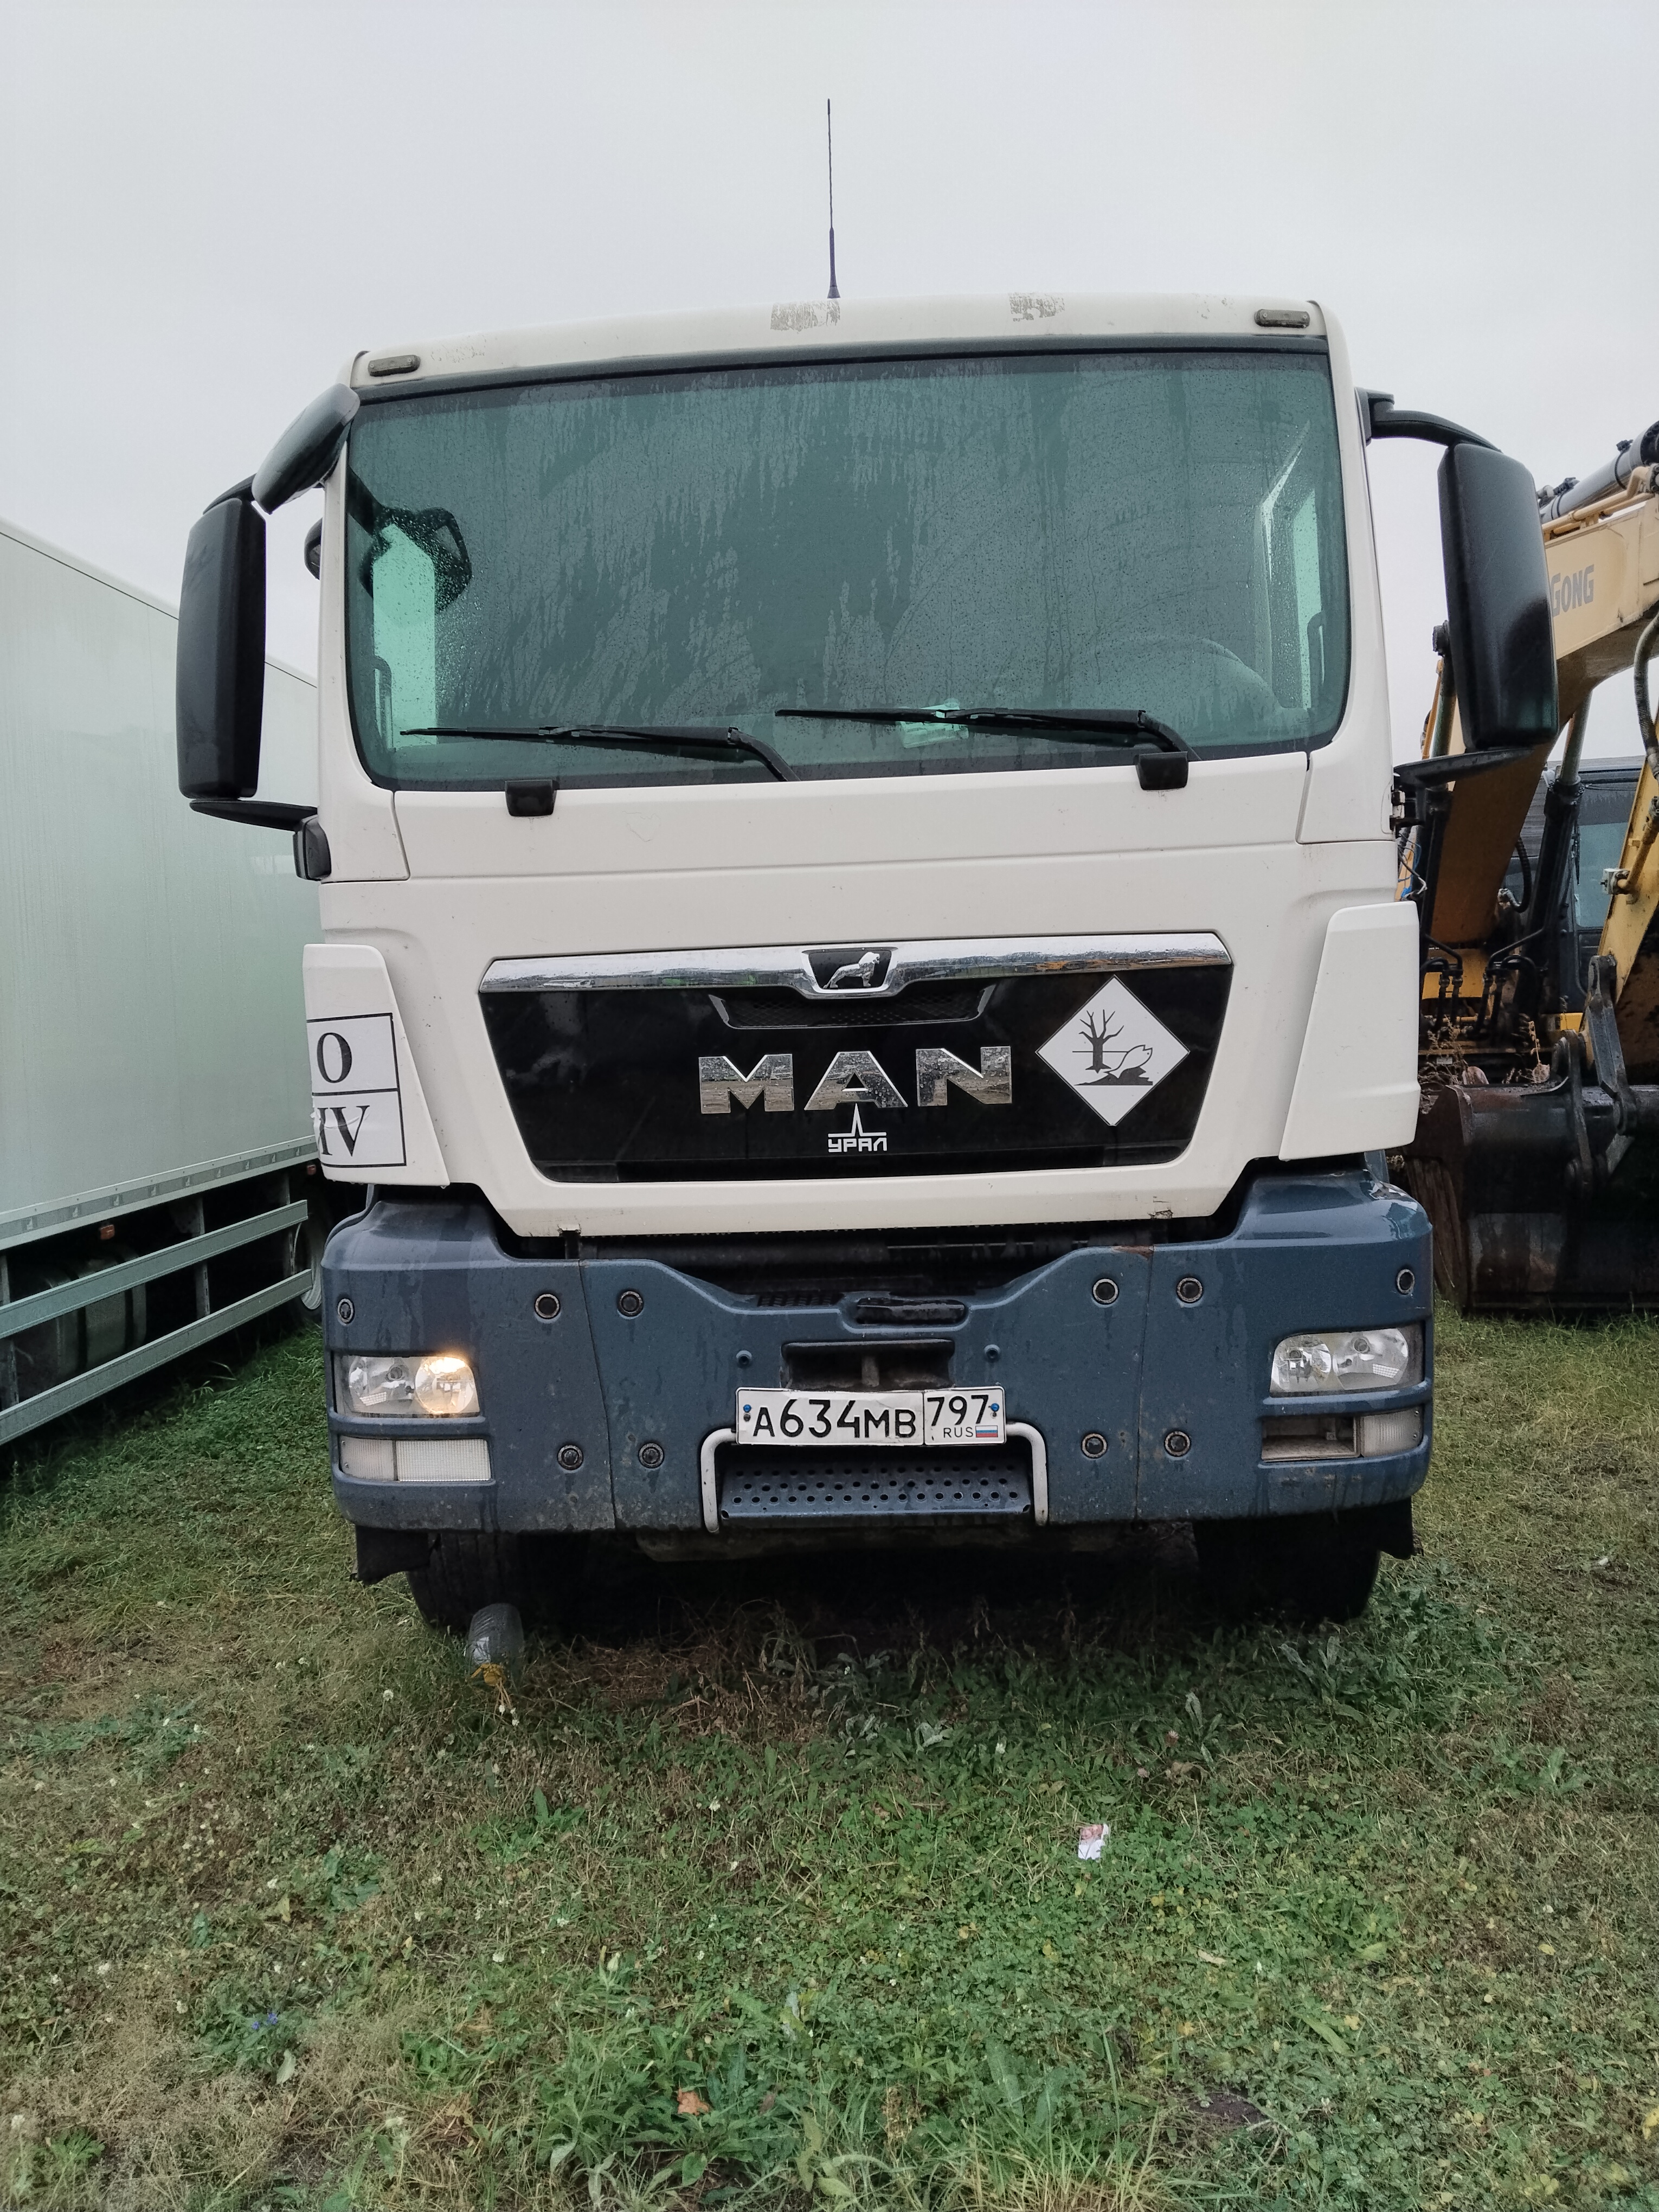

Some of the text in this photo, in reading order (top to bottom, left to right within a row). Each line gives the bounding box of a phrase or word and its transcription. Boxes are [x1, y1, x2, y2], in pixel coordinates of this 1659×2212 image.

[698, 1046, 1013, 1114] MAN
[317, 1105, 370, 1157] IV
[828, 1137, 888, 1153] УРАЛ
[927, 1394, 989, 1426] 797
[943, 1426, 974, 1438] RUS
